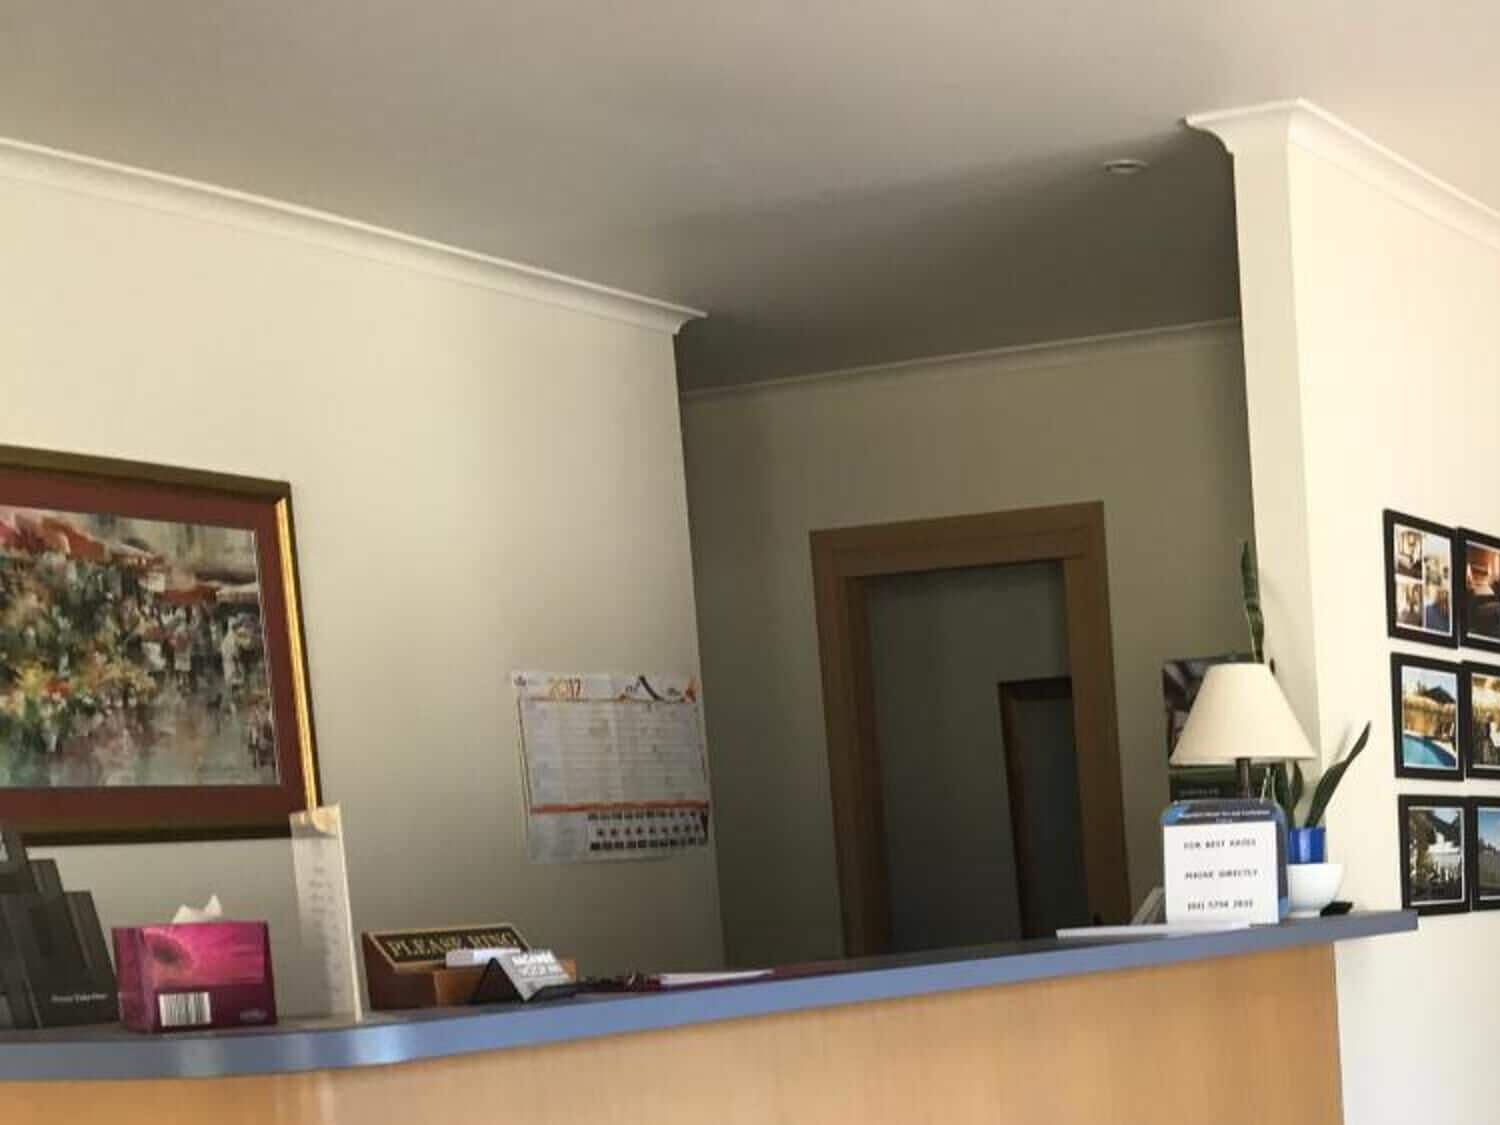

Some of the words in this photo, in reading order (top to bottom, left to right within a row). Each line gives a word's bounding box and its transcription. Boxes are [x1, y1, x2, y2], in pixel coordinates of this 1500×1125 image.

[1183, 840, 1201, 850] FOR
[1205, 839, 1225, 849] BEST
[1229, 837, 1257, 848] RATES
[1218, 868, 1258, 878] DIRECTLY
[385, 936, 464, 958] PLEASE
[465, 931, 521, 950] RING
